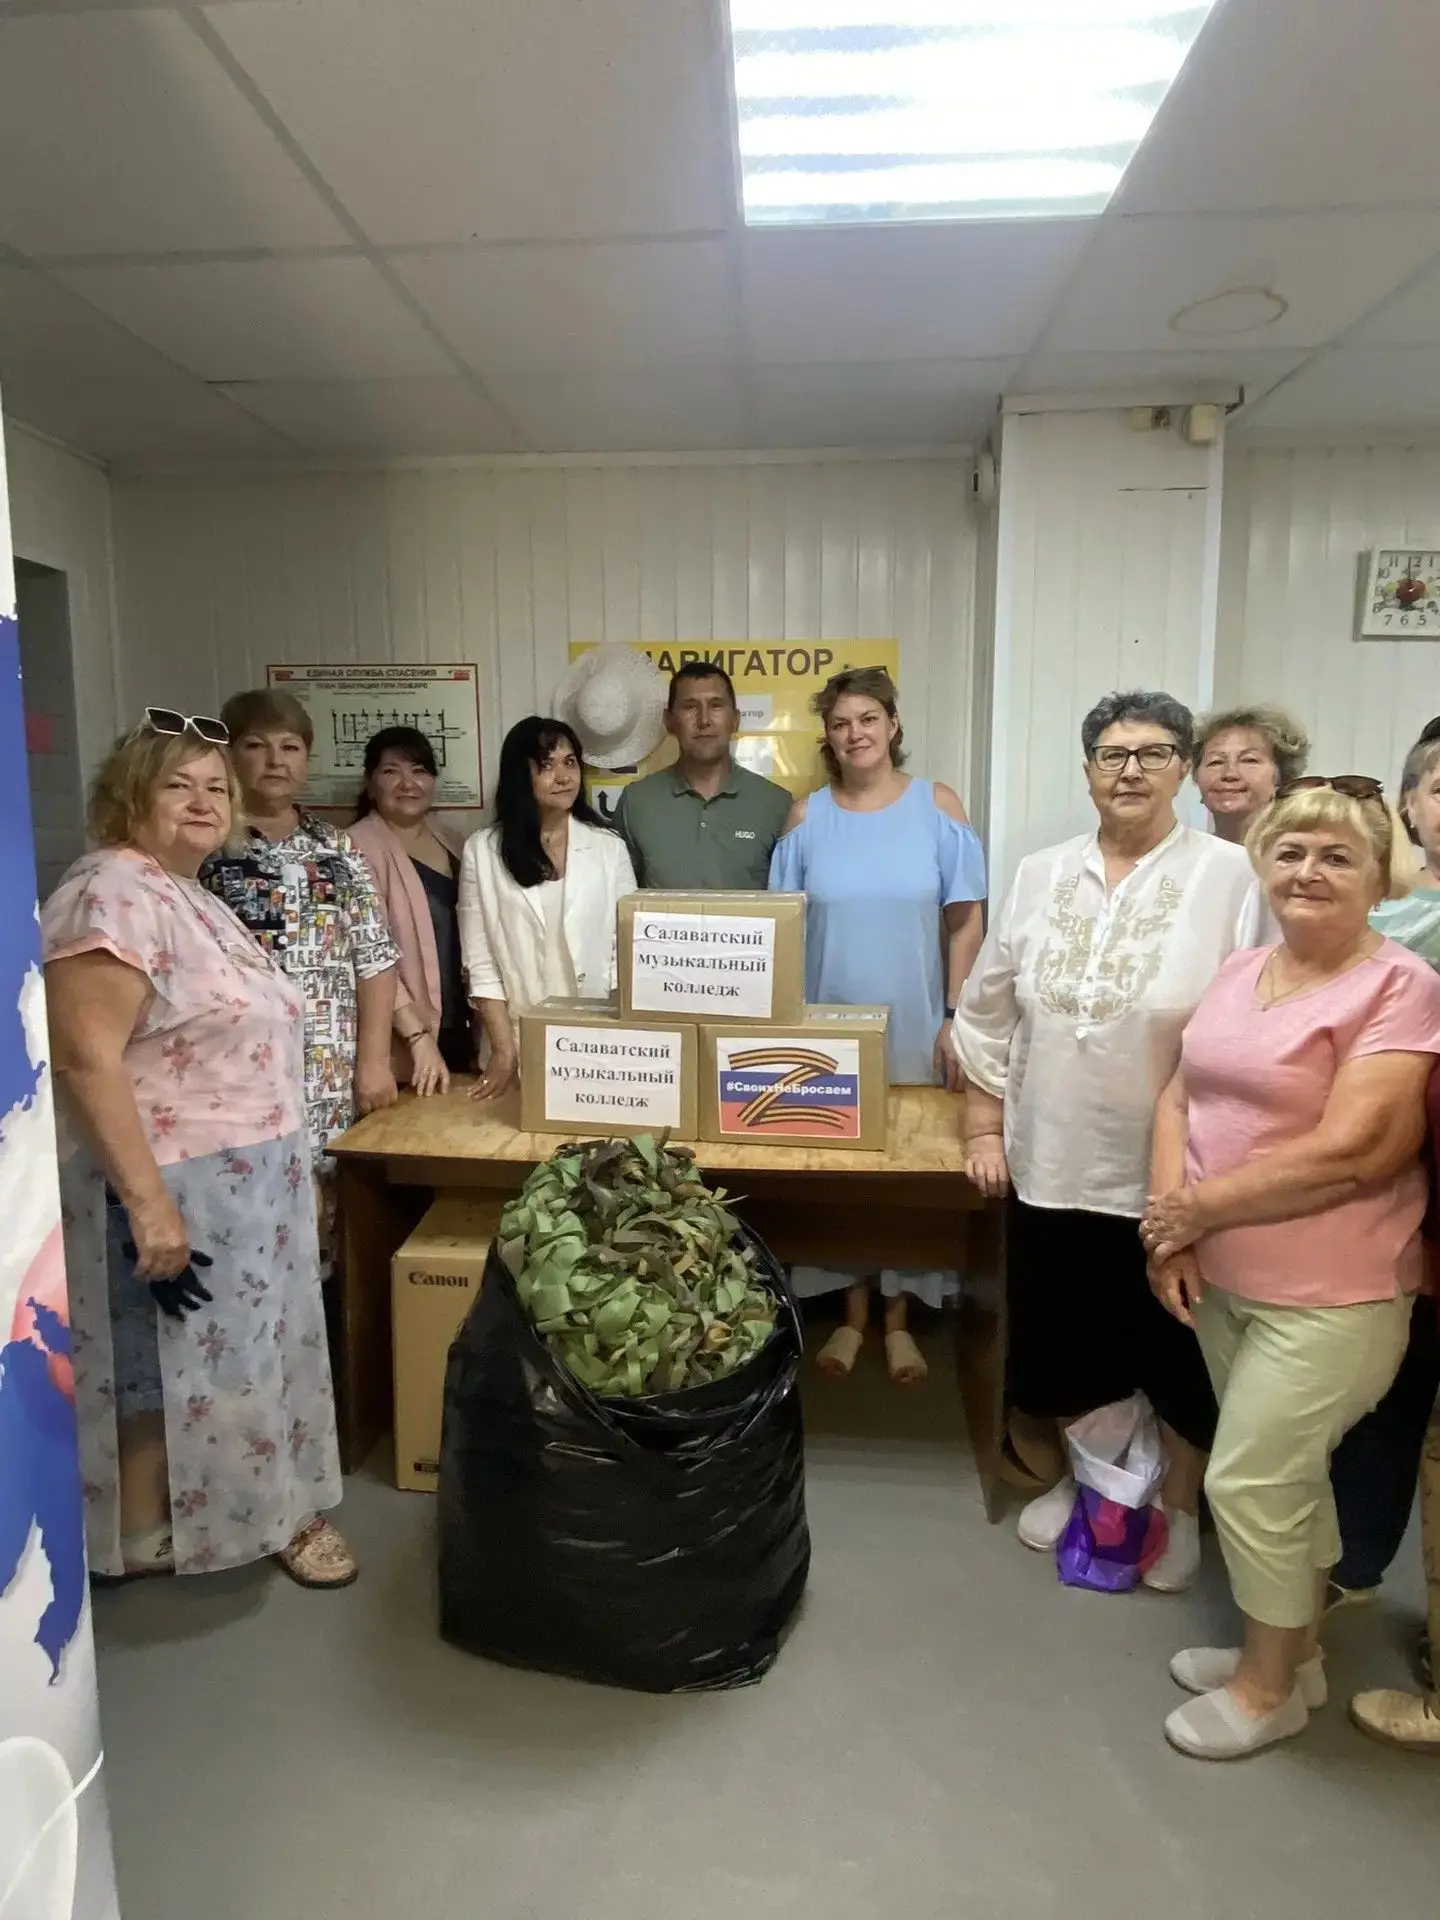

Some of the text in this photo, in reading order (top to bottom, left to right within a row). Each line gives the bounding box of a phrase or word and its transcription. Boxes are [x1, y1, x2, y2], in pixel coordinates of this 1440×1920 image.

[645, 648, 833, 677] АВИГАТОР
[735, 830, 755, 839] HUGO
[643, 924, 763, 945] Салаватский
[638, 953, 766, 972] музыкальный
[663, 981, 740, 996] колледж
[556, 1037, 670, 1058] Салаватский
[551, 1066, 674, 1084] музыкальный
[726, 1081, 852, 1095] #СвоихНеБросаем
[575, 1093, 649, 1108] колледж
[409, 1271, 469, 1287] Canon
